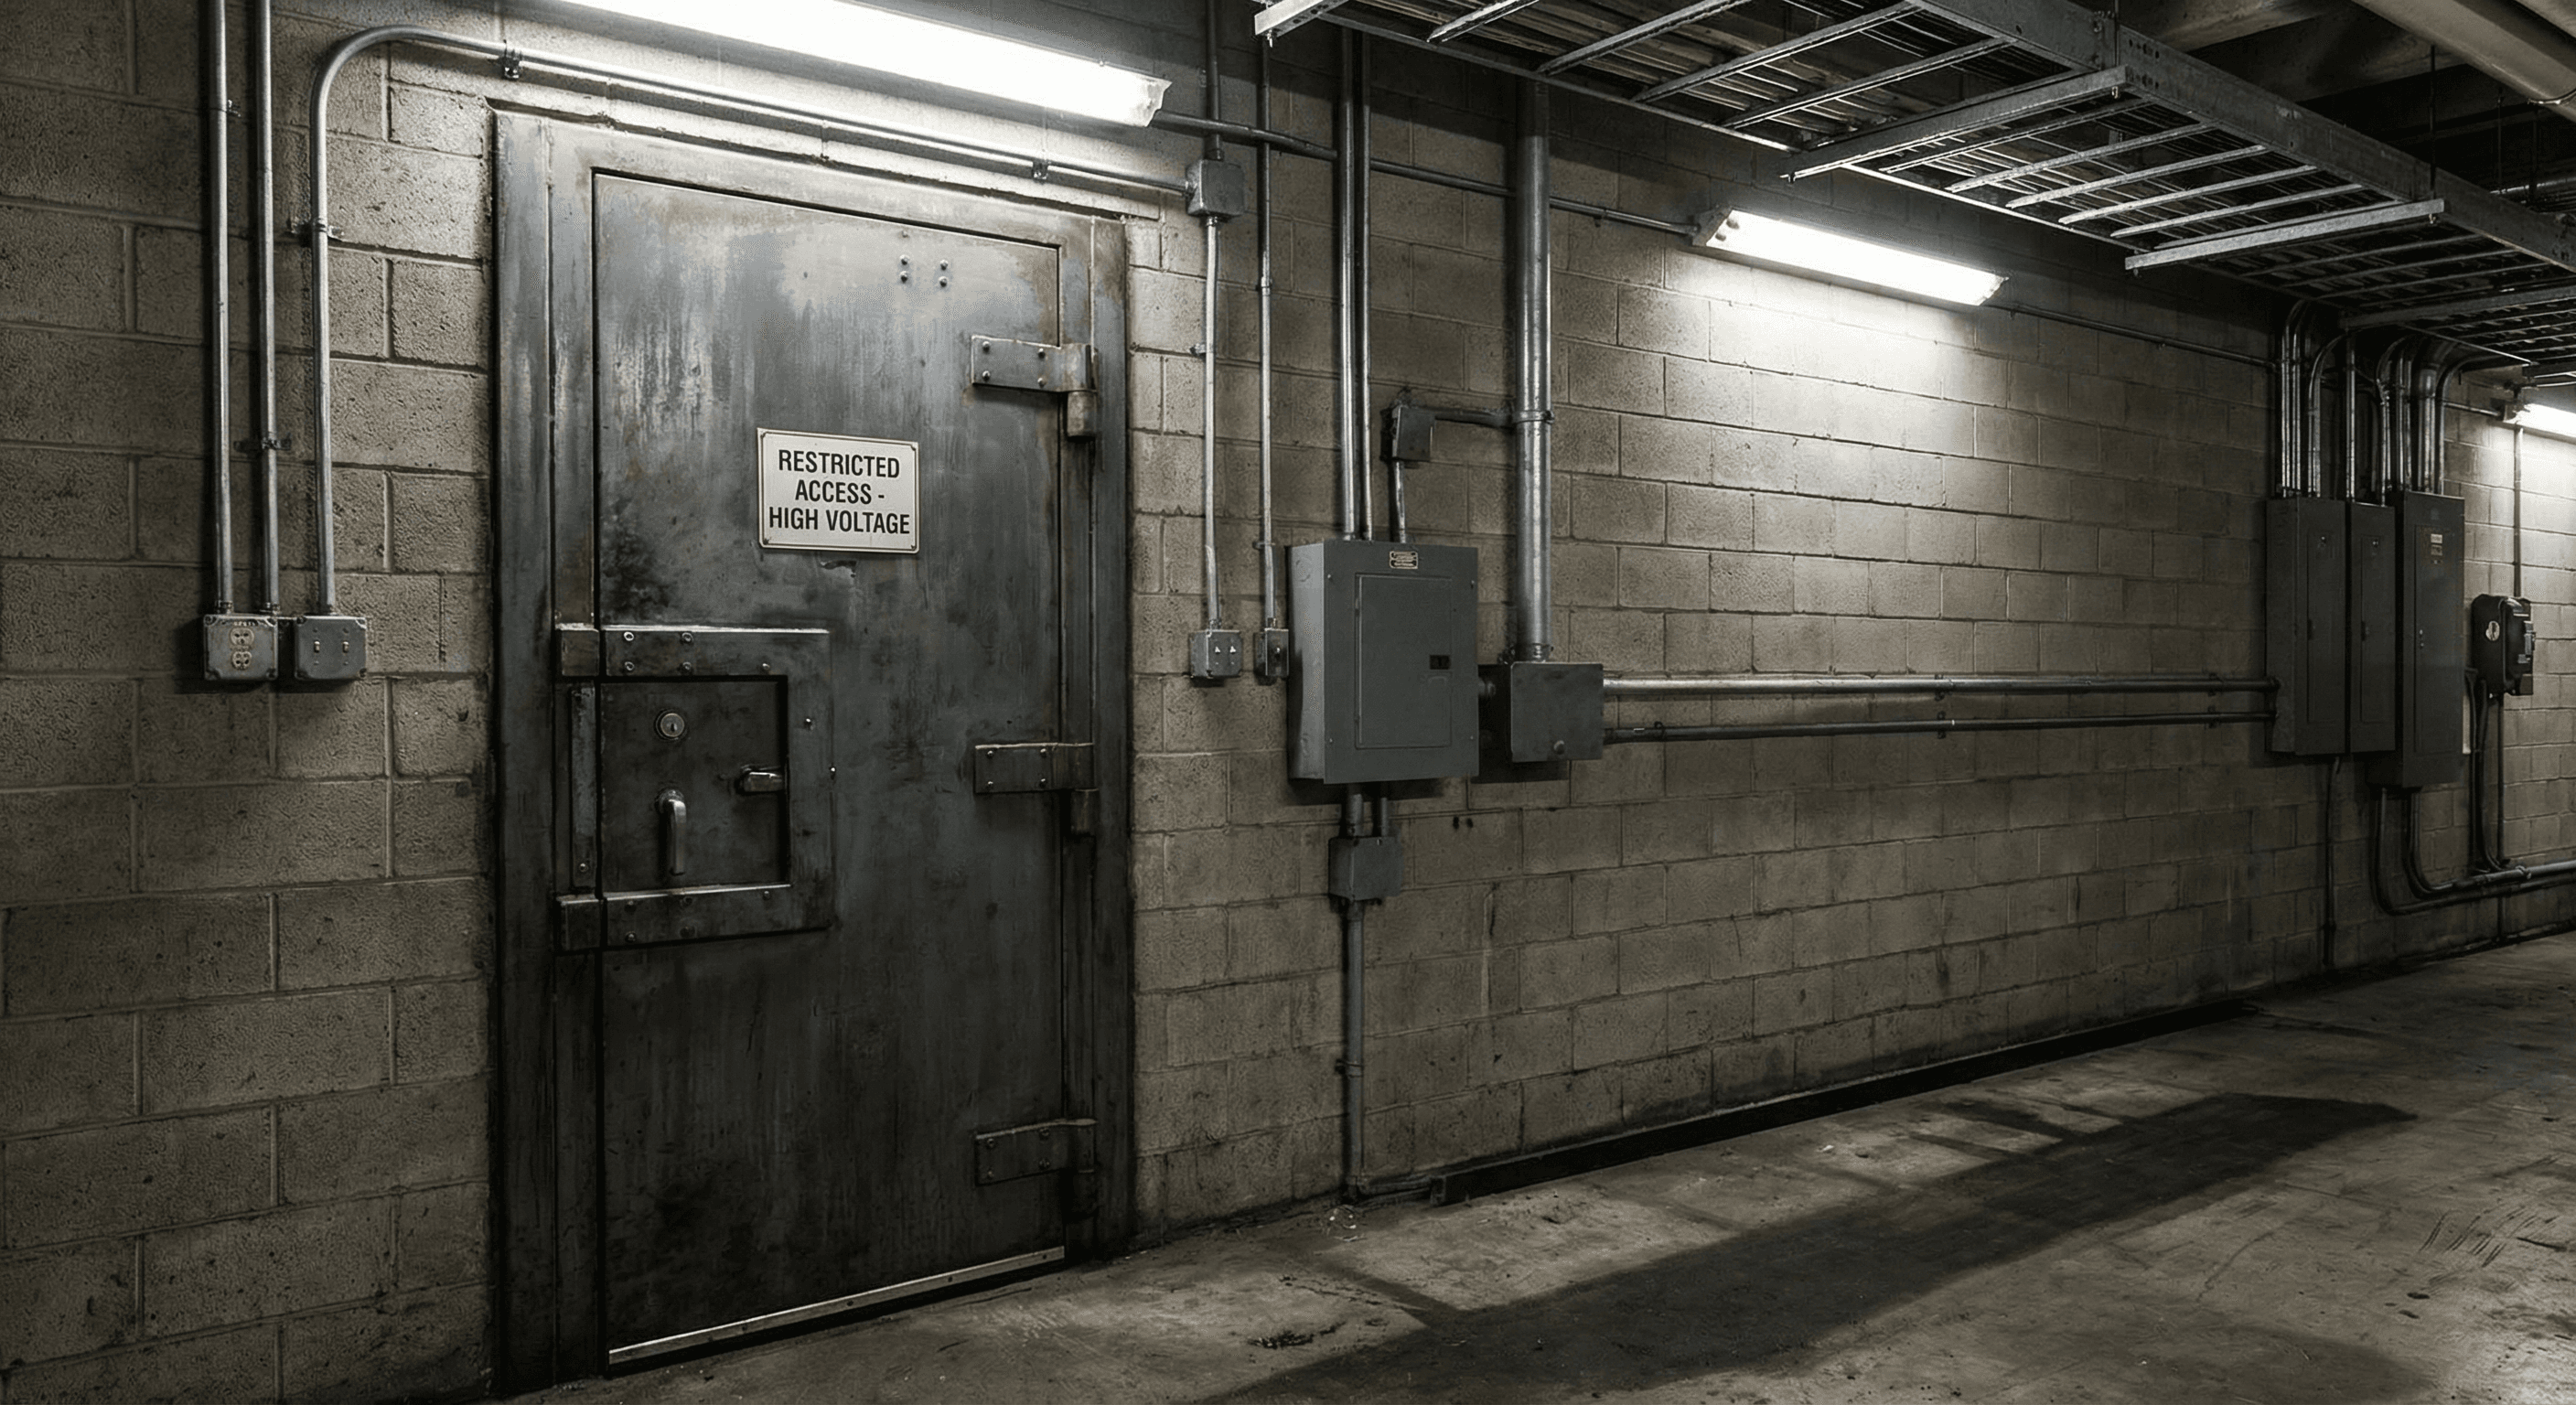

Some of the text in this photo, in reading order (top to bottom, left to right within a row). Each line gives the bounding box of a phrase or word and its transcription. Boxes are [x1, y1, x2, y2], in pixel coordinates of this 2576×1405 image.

[778, 449, 900, 477] RESTRICTED
[795, 479, 872, 504] ACCESS
[769, 507, 910, 534] HIGH VOLTAGE
